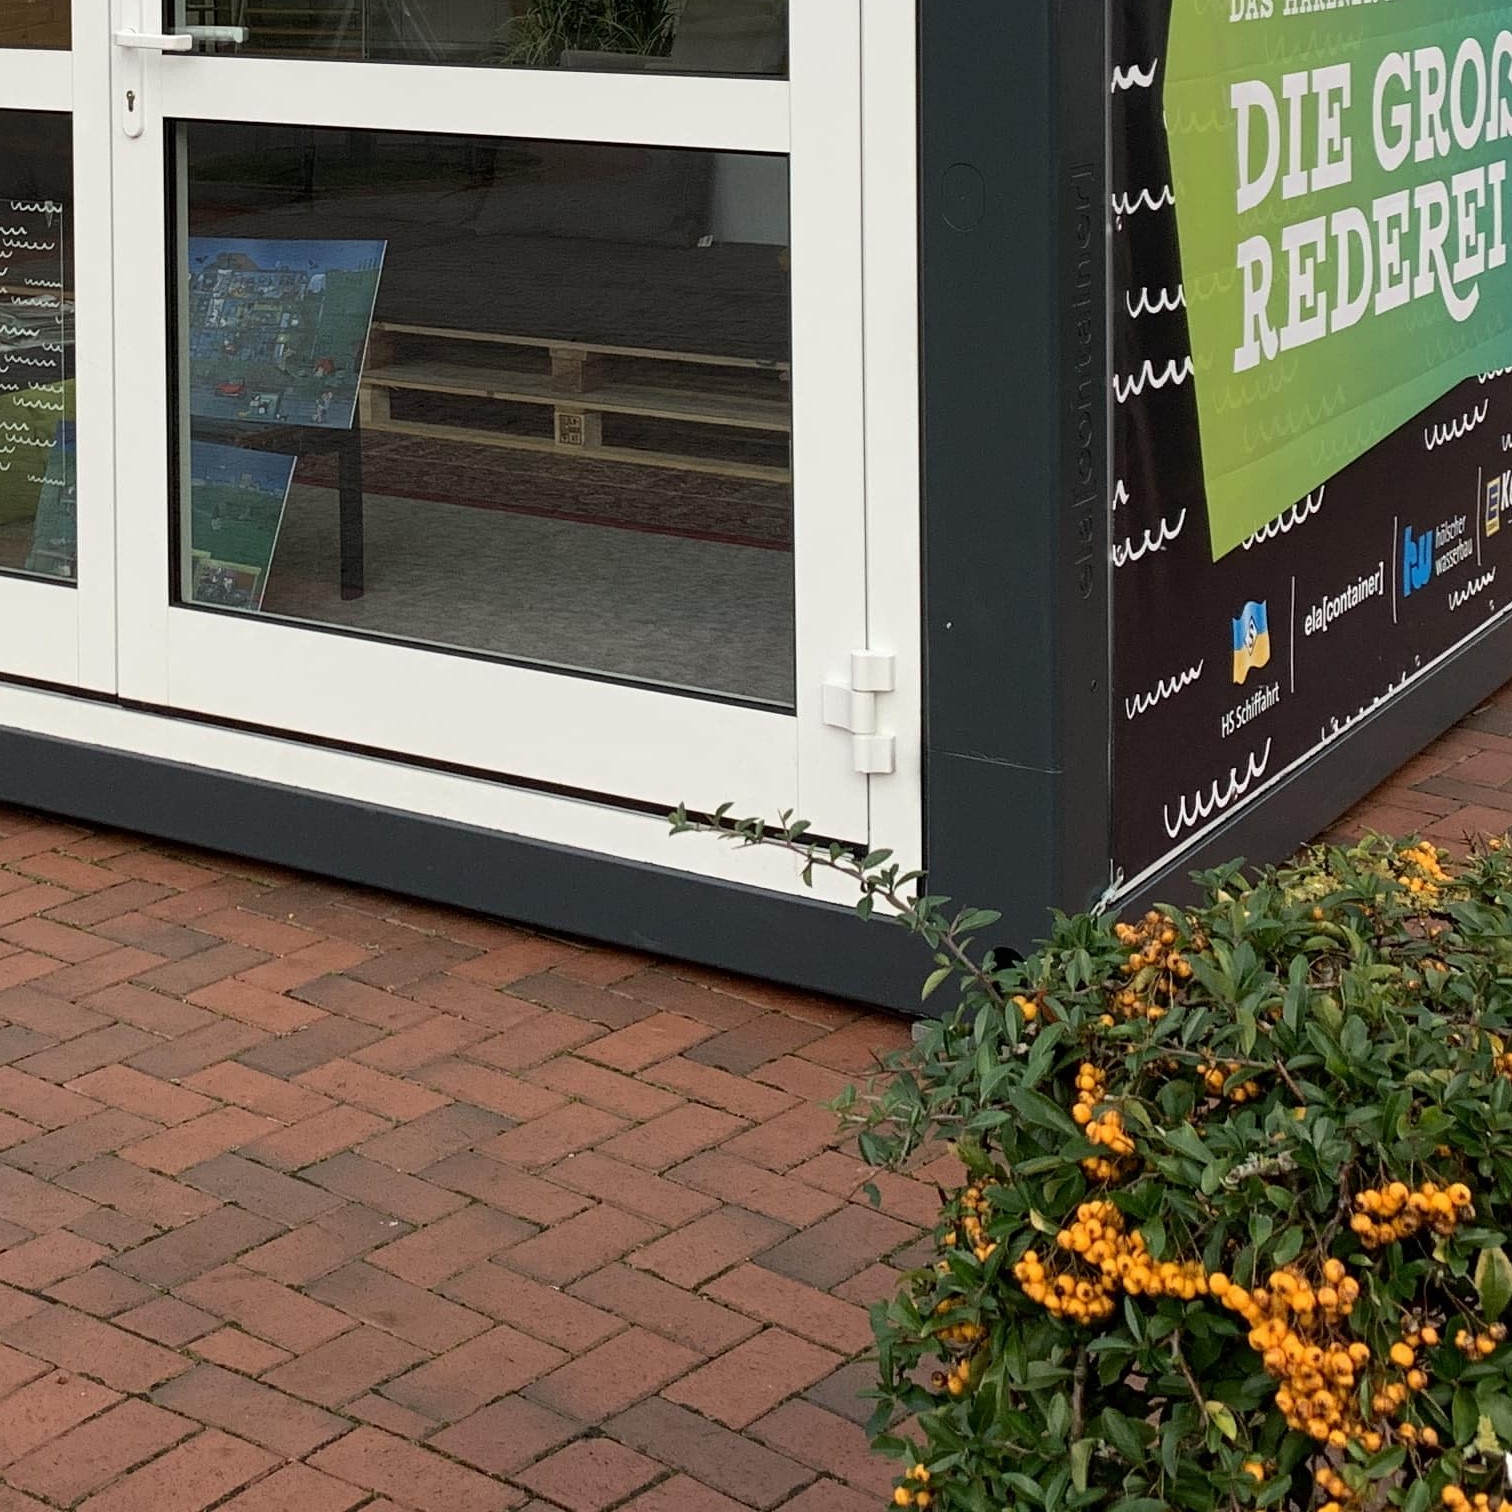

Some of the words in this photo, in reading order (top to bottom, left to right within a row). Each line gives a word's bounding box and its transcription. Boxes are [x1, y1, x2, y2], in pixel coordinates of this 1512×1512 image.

[1230, 62, 1353, 215] DIE
[1233, 159, 1507, 374] REDEREI
[1435, 515, 1467, 550] hölscher
[1435, 538, 1474, 576] wasserbau
[1304, 561, 1385, 637] ela[container]
[1221, 709, 1235, 739] HS
